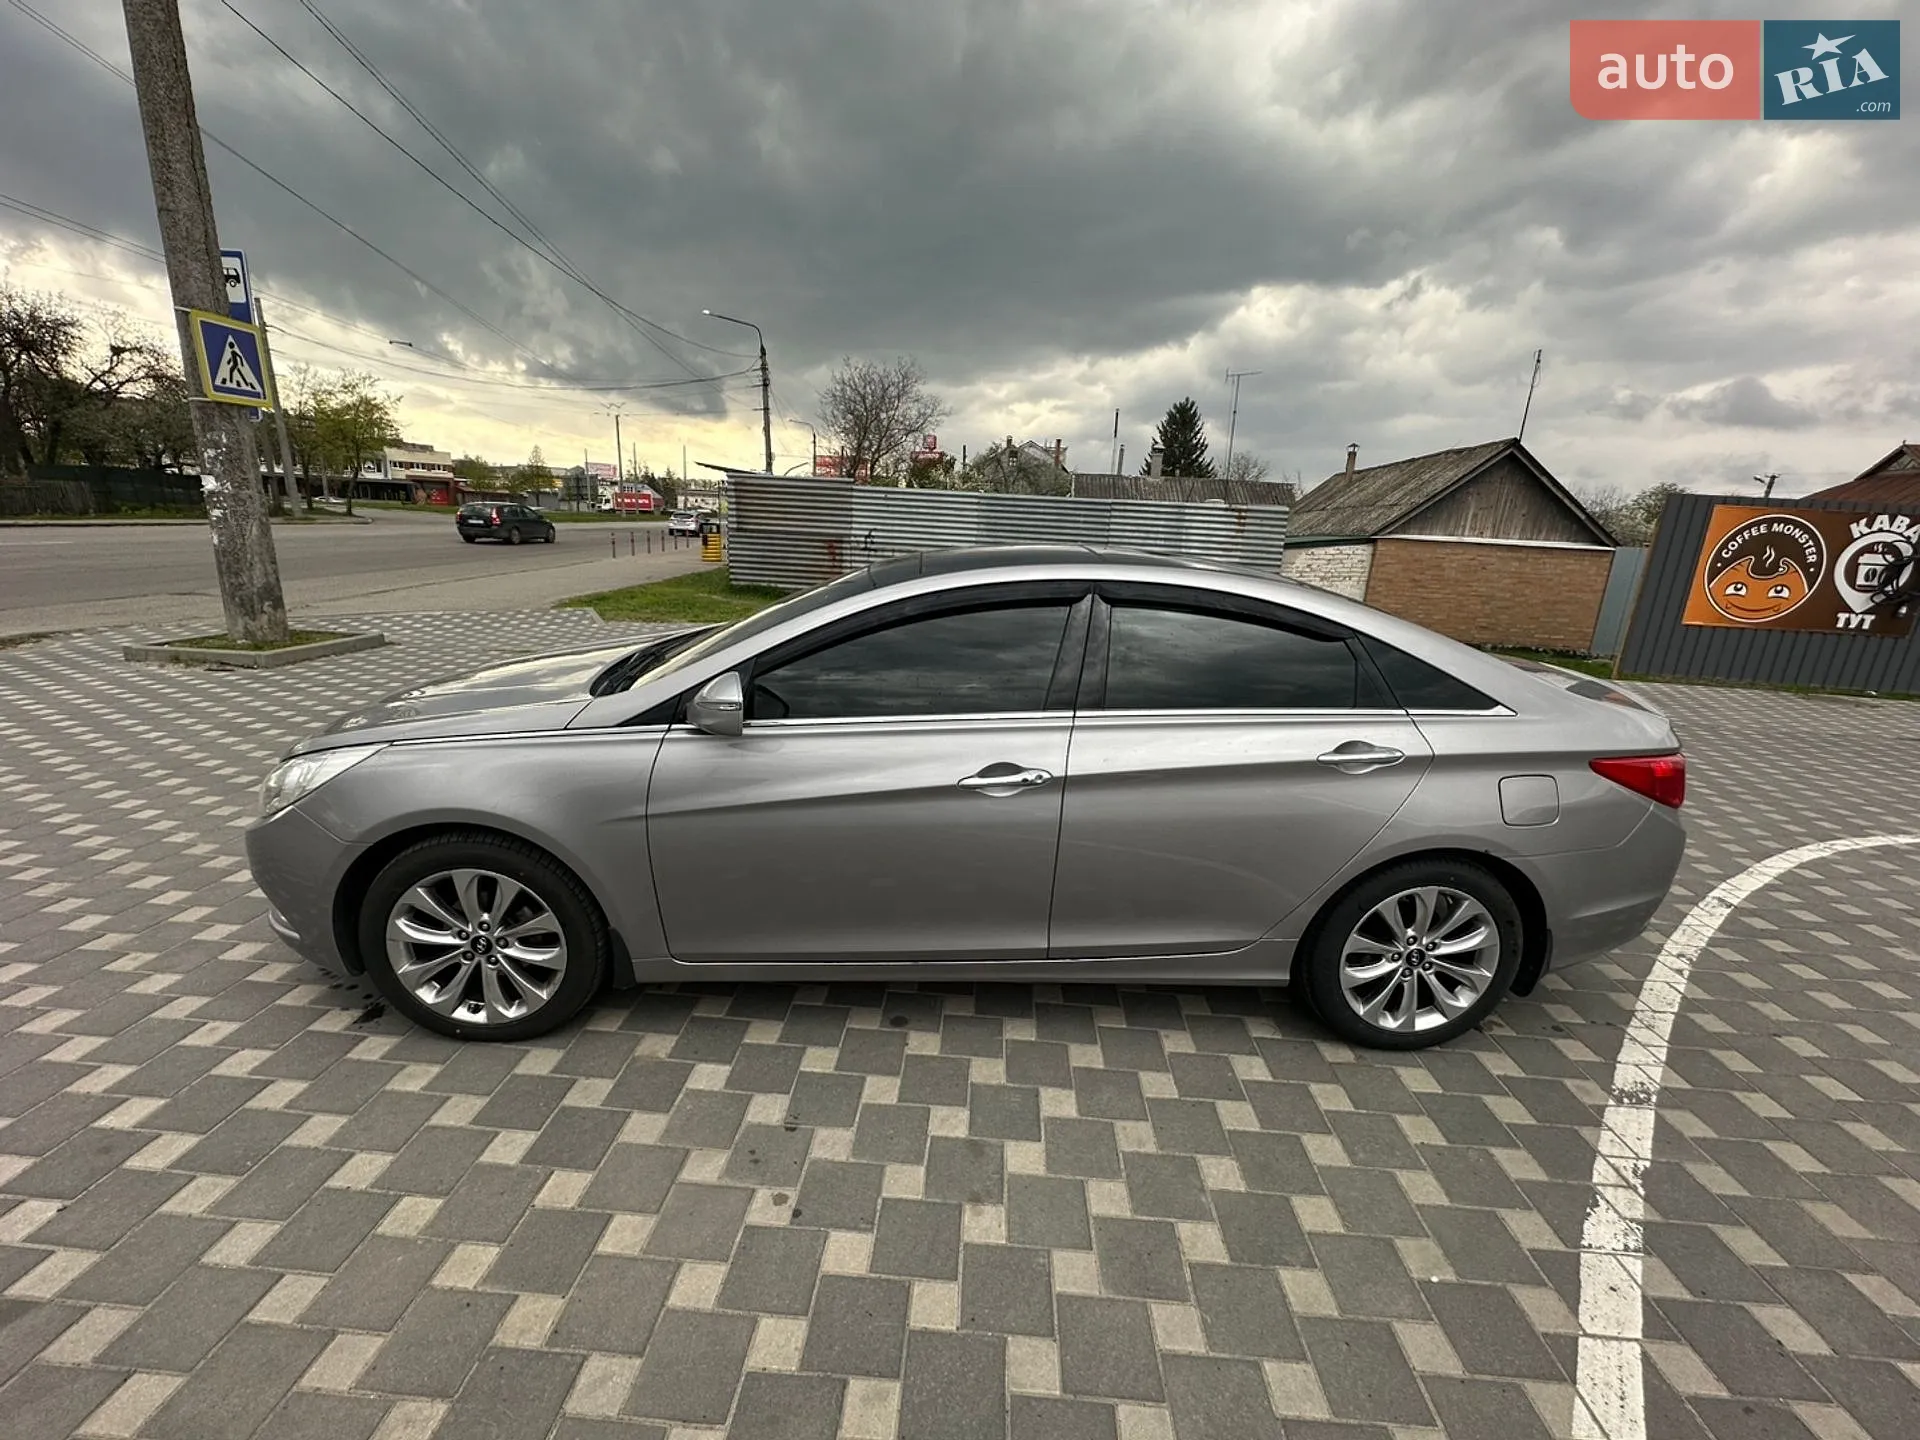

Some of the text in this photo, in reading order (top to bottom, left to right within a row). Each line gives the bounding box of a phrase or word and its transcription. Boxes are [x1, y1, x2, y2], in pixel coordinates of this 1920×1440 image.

[1721, 522, 1819, 564] COFFEE MONSTER
[1849, 514, 1920, 544] КАВА
[1836, 612, 1876, 630] ТУТ
